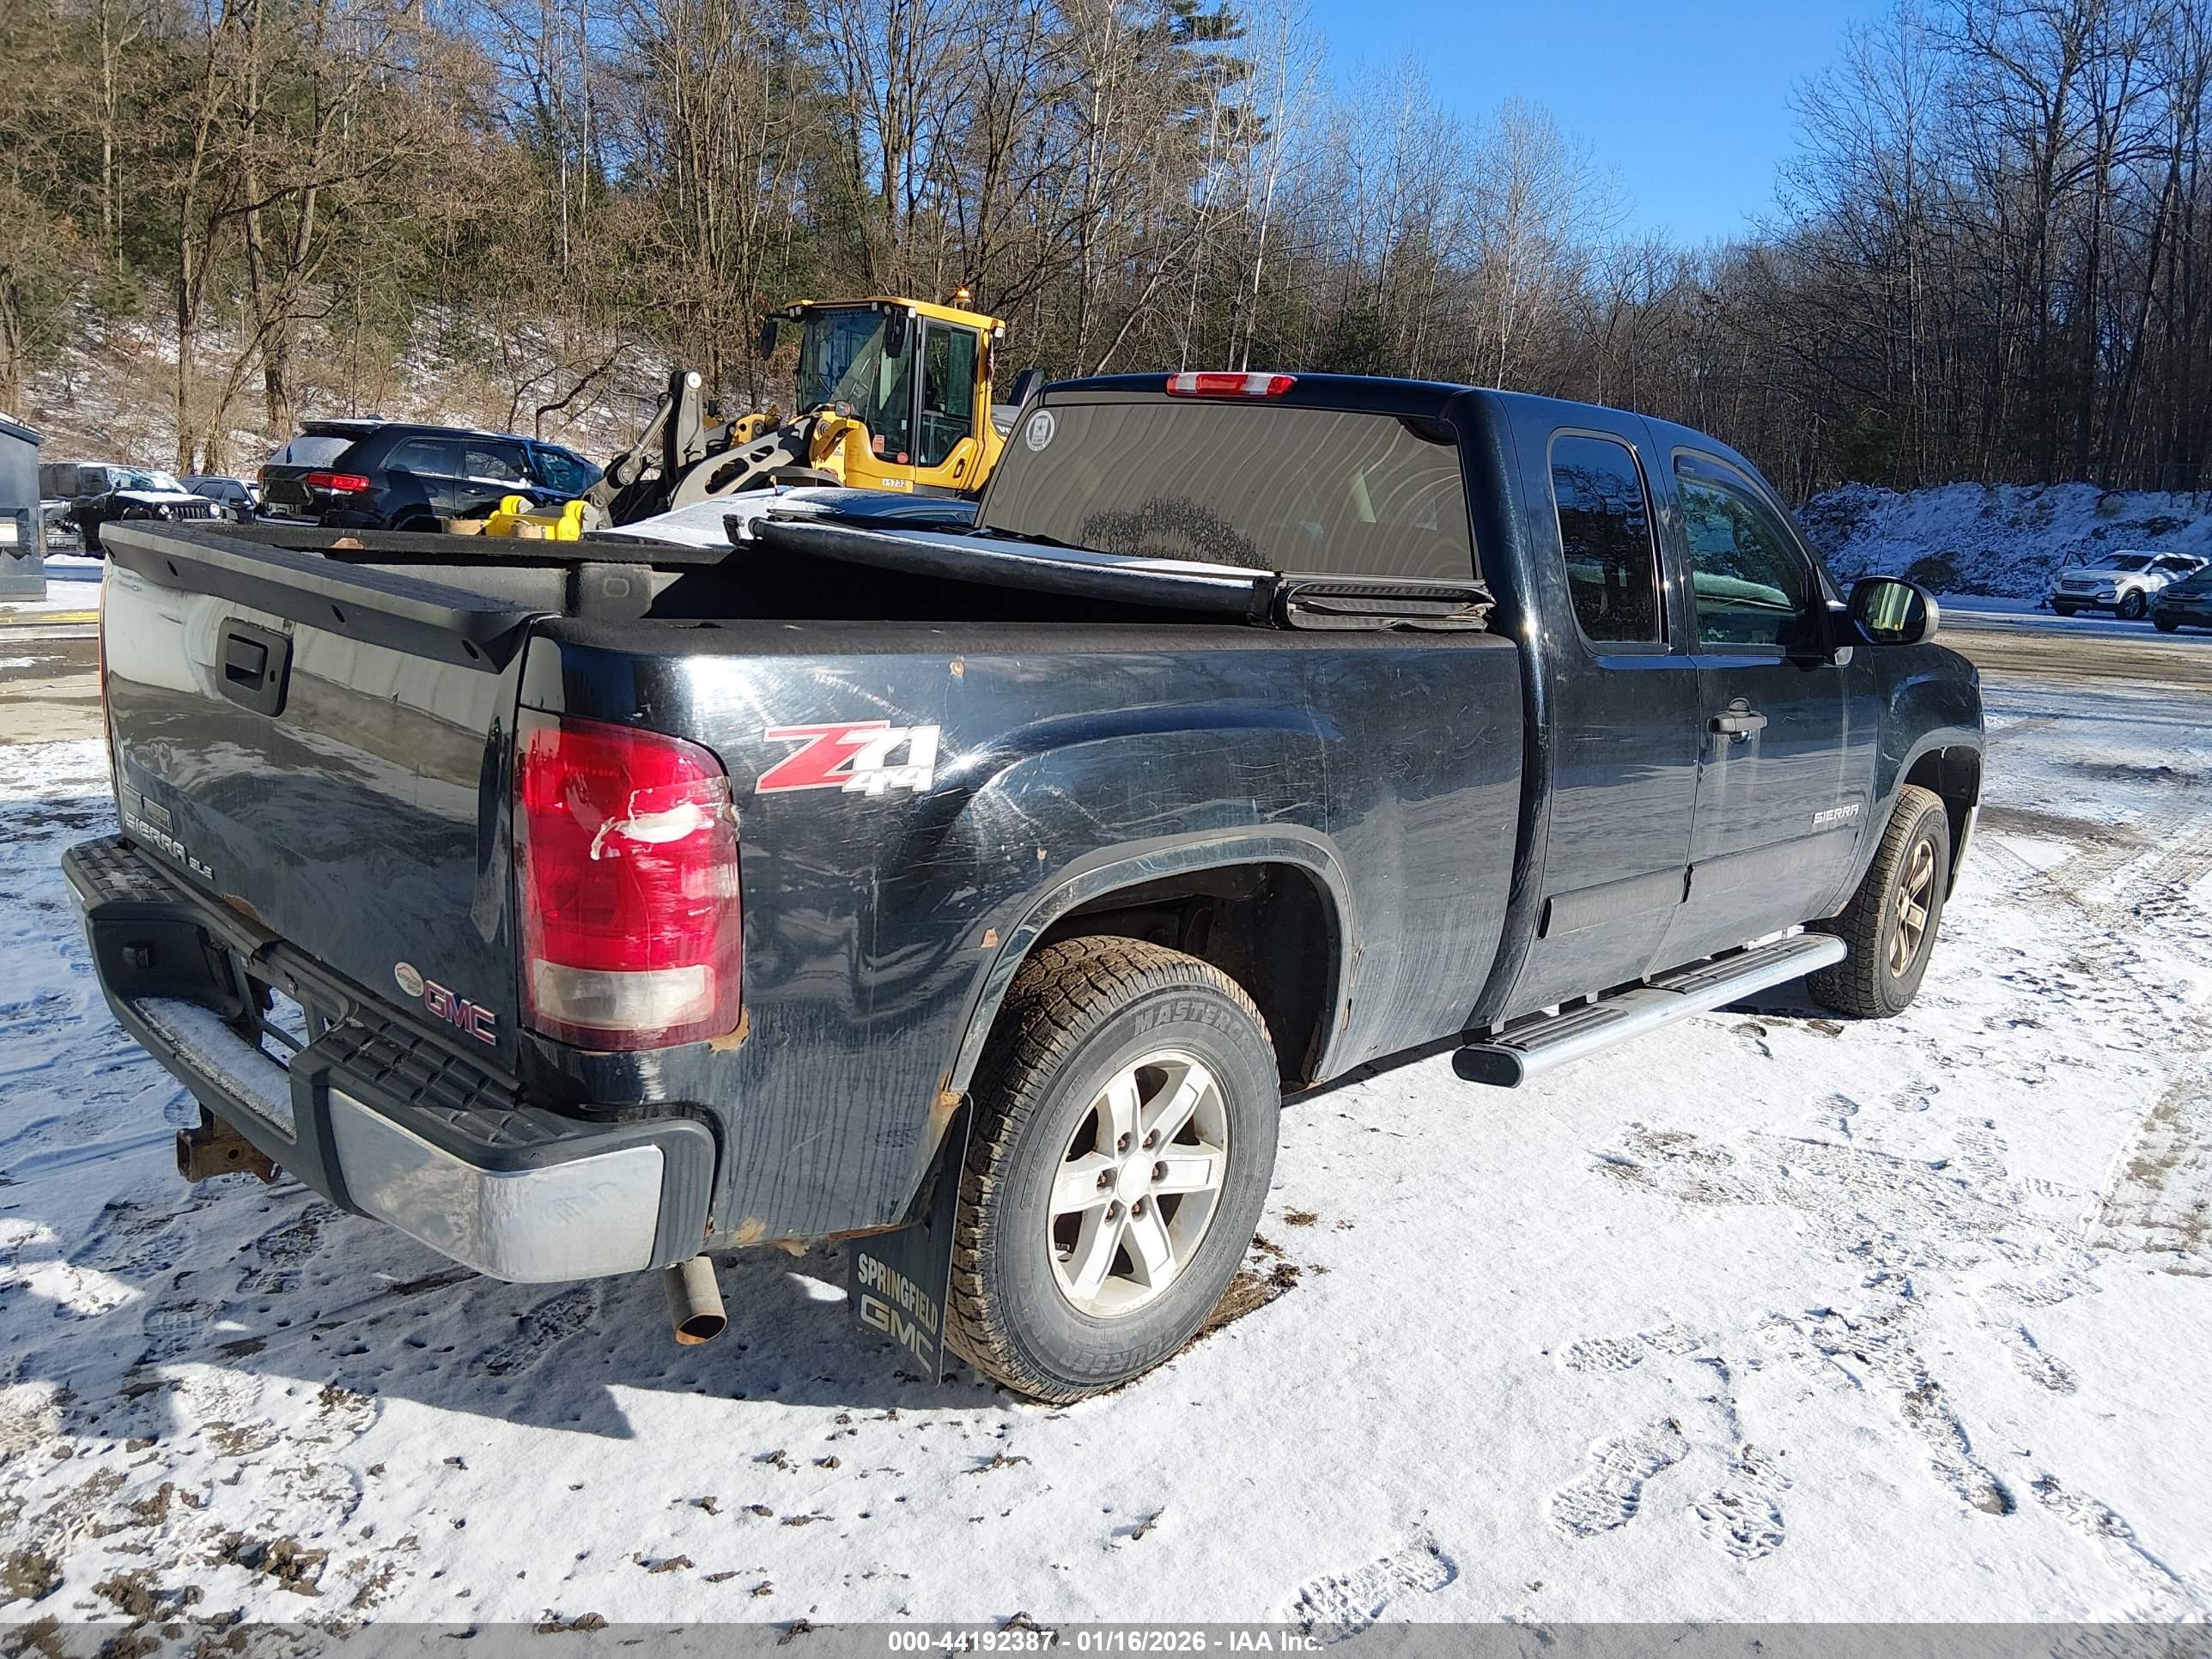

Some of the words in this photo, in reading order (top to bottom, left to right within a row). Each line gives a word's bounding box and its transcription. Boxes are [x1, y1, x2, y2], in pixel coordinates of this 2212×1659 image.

[754, 720, 941, 795] Z71
[124, 811, 188, 865] SIERRA
[188, 856, 215, 880] SLE
[1812, 804, 1860, 824] SIERRA
[424, 979, 498, 1047] GMC
[858, 1253, 939, 1335] SPRINGFIELD
[860, 1293, 934, 1375] GMC
